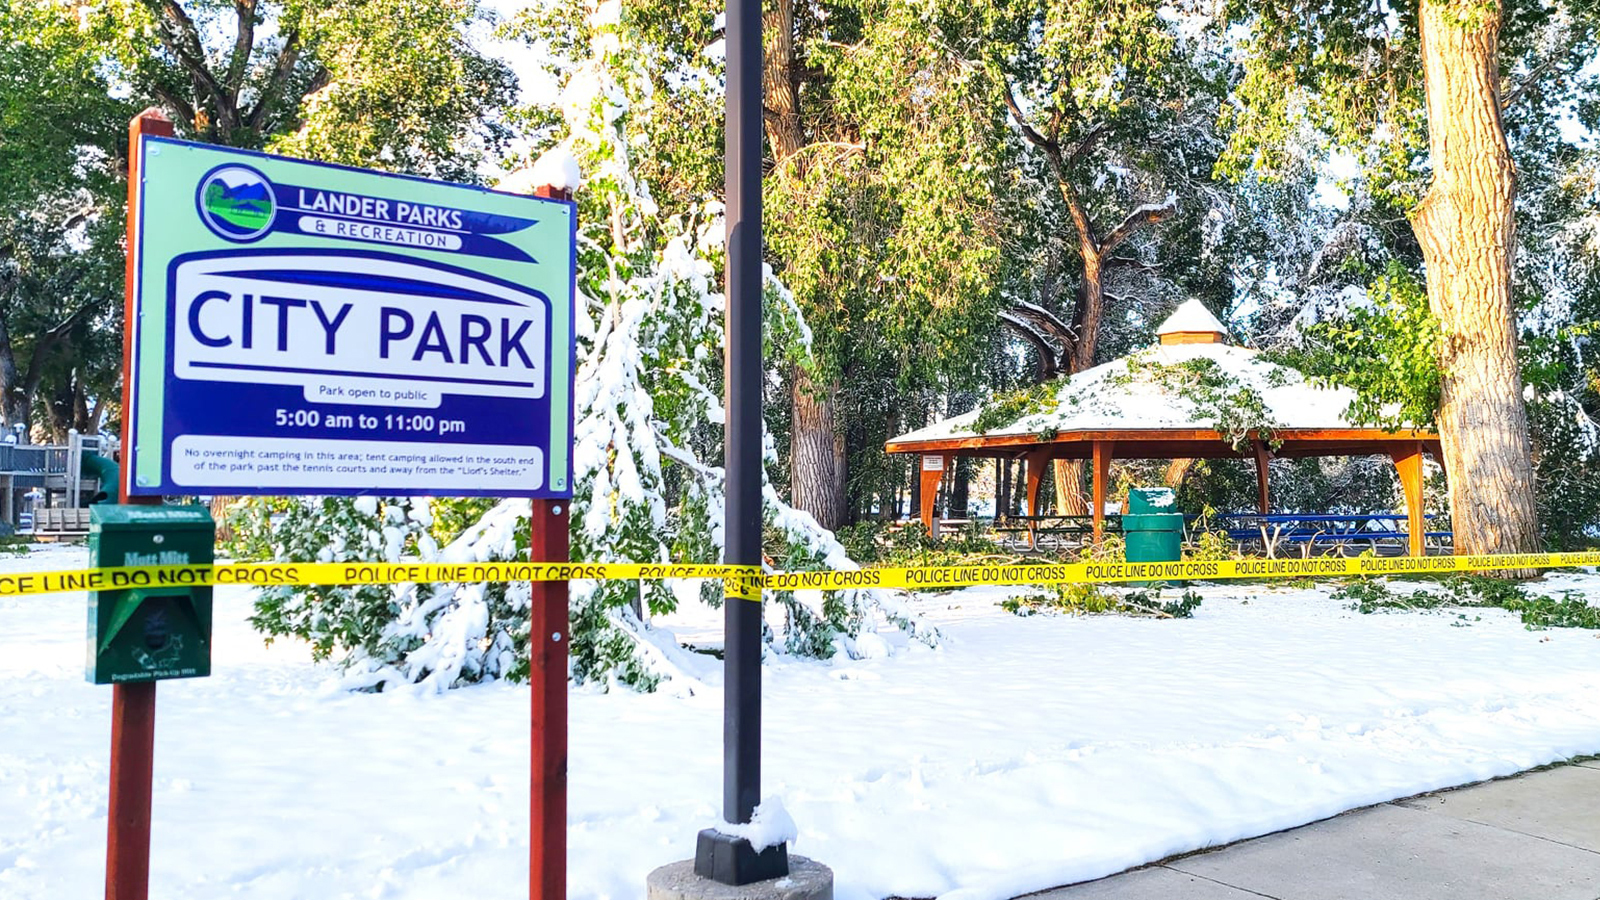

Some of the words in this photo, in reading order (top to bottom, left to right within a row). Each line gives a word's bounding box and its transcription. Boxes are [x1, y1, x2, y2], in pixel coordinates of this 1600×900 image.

[298, 188, 390, 220] LANDER
[397, 203, 463, 230] PARKS
[315, 219, 326, 232] &
[337, 222, 447, 247] RECREATION
[187, 289, 354, 355] CITY
[379, 306, 536, 369] PARK
[319, 385, 344, 396] Park
[348, 388, 376, 399] open
[379, 390, 391, 398] to
[394, 389, 428, 400] public
[275, 408, 320, 427] 5:00
[324, 414, 354, 428] am
[359, 414, 378, 429] to
[384, 414, 434, 432] 11:00
[439, 418, 466, 436] pm
[184, 448, 200, 458] No
[203, 449, 255, 460] overnight
[258, 450, 301, 461] camping
[304, 452, 313, 460] in
[316, 452, 335, 460] this
[338, 454, 362, 462] area;
[366, 453, 386, 462] tent
[388, 454, 427, 464] camping
[429, 454, 464, 464] allowed
[466, 456, 474, 464] in
[476, 456, 491, 464] the
[493, 456, 516, 465] south
[518, 457, 534, 466] end
[194, 461, 205, 470] of
[208, 462, 226, 471] the
[230, 462, 253, 472] park
[257, 463, 280, 474] past
[282, 463, 300, 472] the
[302, 463, 334, 473] tennis
[336, 464, 366, 474] courts
[369, 465, 387, 474] and
[389, 466, 412, 476] away
[416, 466, 437, 474] from
[440, 466, 454, 475] the
[124, 552, 158, 567] Mutt
[159, 550, 190, 565] Mitt
[1235, 562, 1266, 574] POLICE
[1268, 562, 1286, 574] LINE
[1288, 561, 1300, 573] DO
[1302, 560, 1318, 572] NOT
[1320, 560, 1346, 572] CROSS
[1360, 560, 1387, 571] POLICE
[1389, 559, 1404, 570] LINE
[1406, 558, 1416, 570] DO
[1417, 558, 1432, 570] NOT
[1432, 558, 1456, 569] CROSS
[1468, 556, 1490, 568] POLICE
[1492, 556, 1506, 567] LINE
[1506, 556, 1515, 566] DO
[1516, 555, 1529, 566] NOT
[1530, 554, 1550, 565] CROSS
[44, 572, 106, 591] LINE
[112, 570, 150, 586] DO
[158, 568, 211, 584] NOT
[217, 567, 300, 584] CROSS
[345, 567, 420, 582] POLICE
[426, 567, 468, 582] LINE
[473, 566, 500, 581] DO
[505, 566, 543, 580] NOT
[546, 566, 607, 580] CROSS
[906, 569, 950, 584] POLICE
[953, 568, 980, 582] LINE
[982, 568, 1000, 582] DO
[1002, 567, 1026, 581] NOT
[1027, 566, 1066, 580] CROSS
[1086, 566, 1123, 578] POLICE
[1125, 564, 1147, 578] LINE
[1148, 564, 1163, 577] DO
[1165, 564, 1185, 576] NOT
[1186, 563, 1218, 576] CROSS
[778, 574, 798, 588] DO
[802, 572, 831, 587] NOT
[834, 571, 880, 586] CROSS
